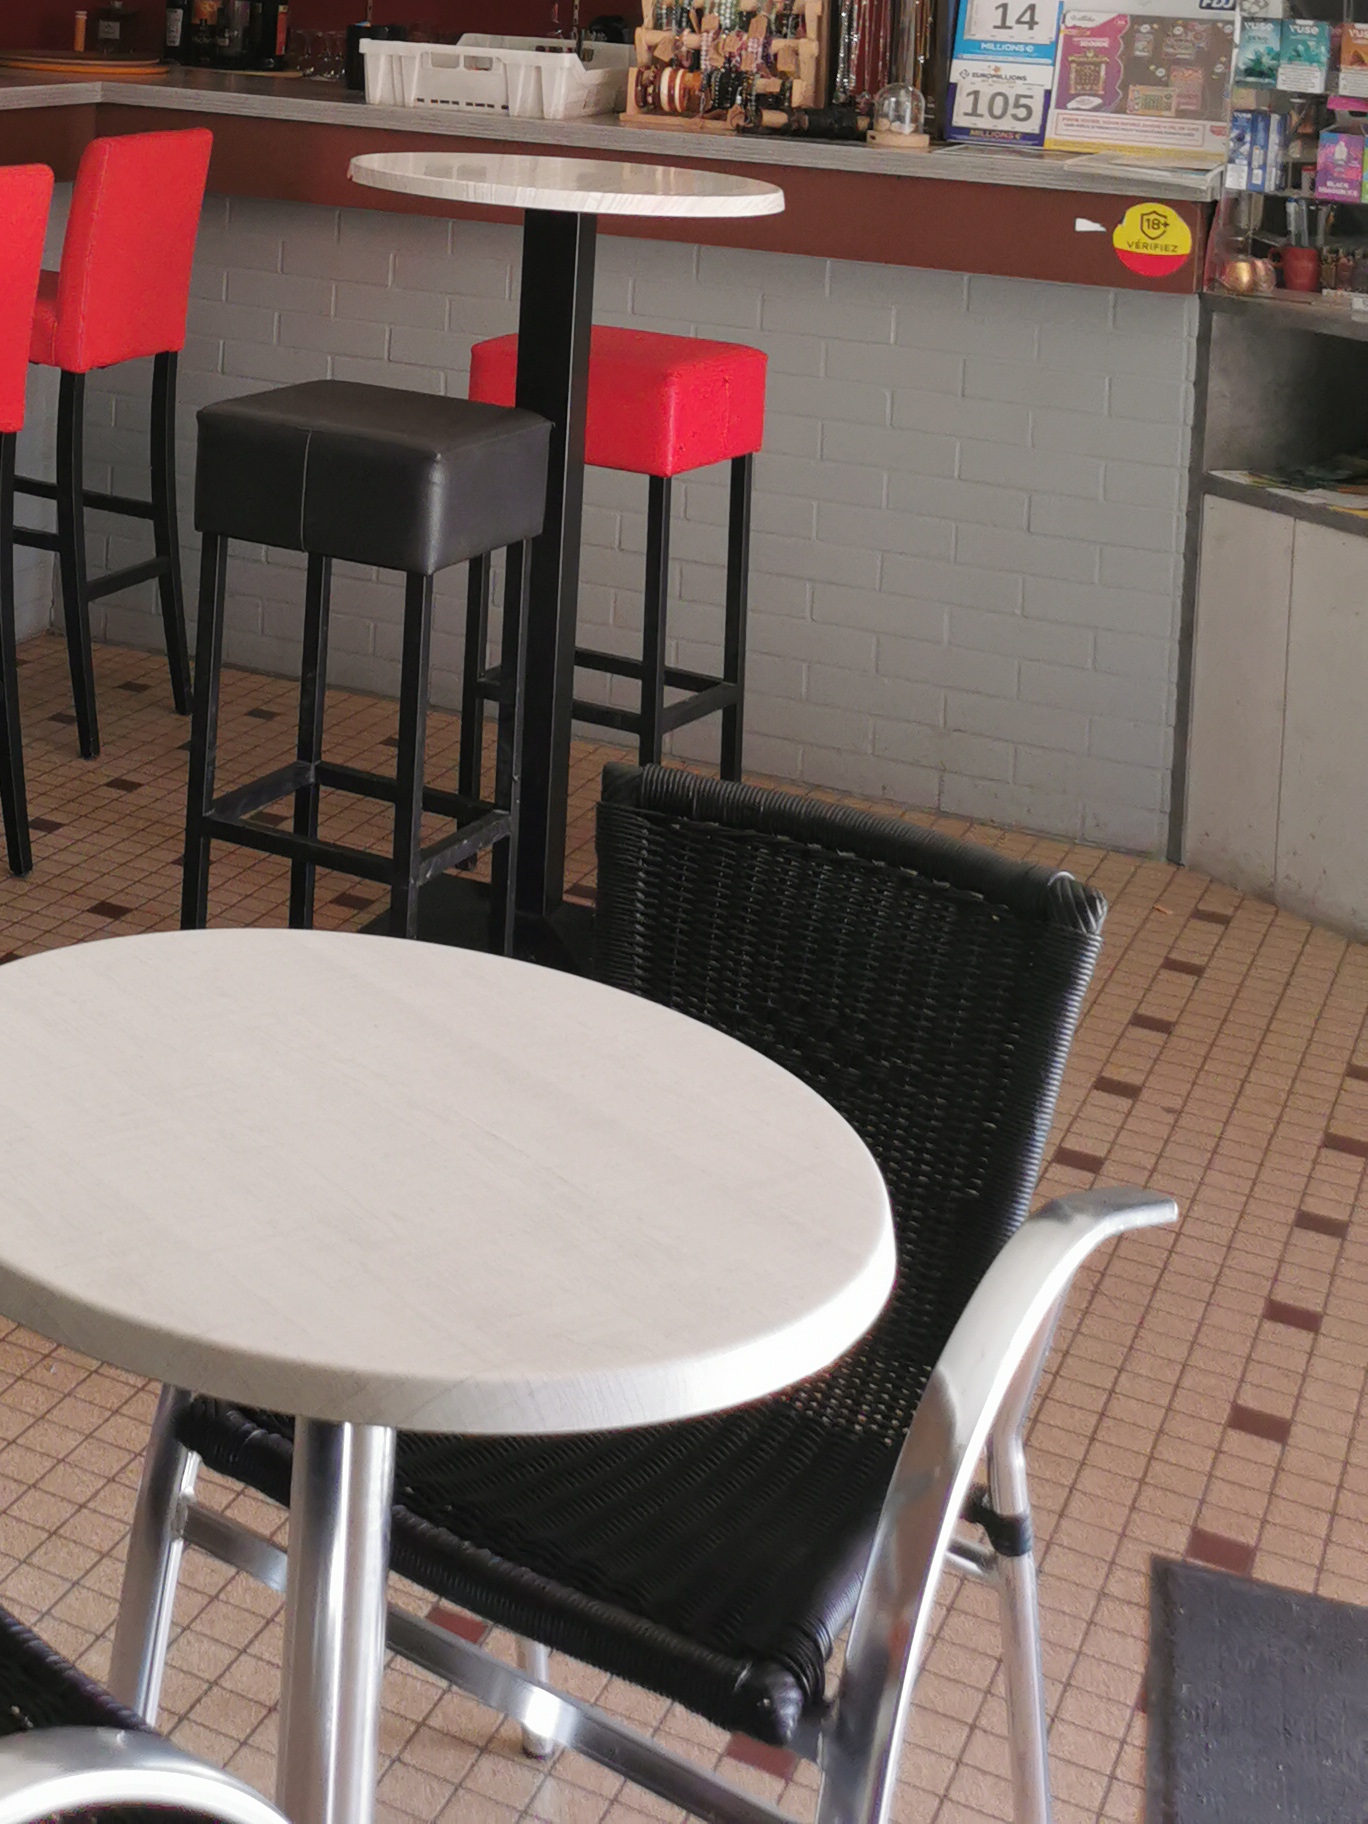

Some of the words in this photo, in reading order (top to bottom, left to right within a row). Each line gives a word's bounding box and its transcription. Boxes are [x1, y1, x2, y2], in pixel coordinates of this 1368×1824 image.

[993, 2, 1039, 30] 14
[980, 42, 1025, 52] MILLIONS
[972, 71, 1028, 82] EUROMILLIONS
[963, 89, 1034, 122] 105
[969, 129, 1014, 140] MILLIONS
[1145, 218, 1170, 230] 18+
[1126, 239, 1179, 253] VÉRIFIEZ
